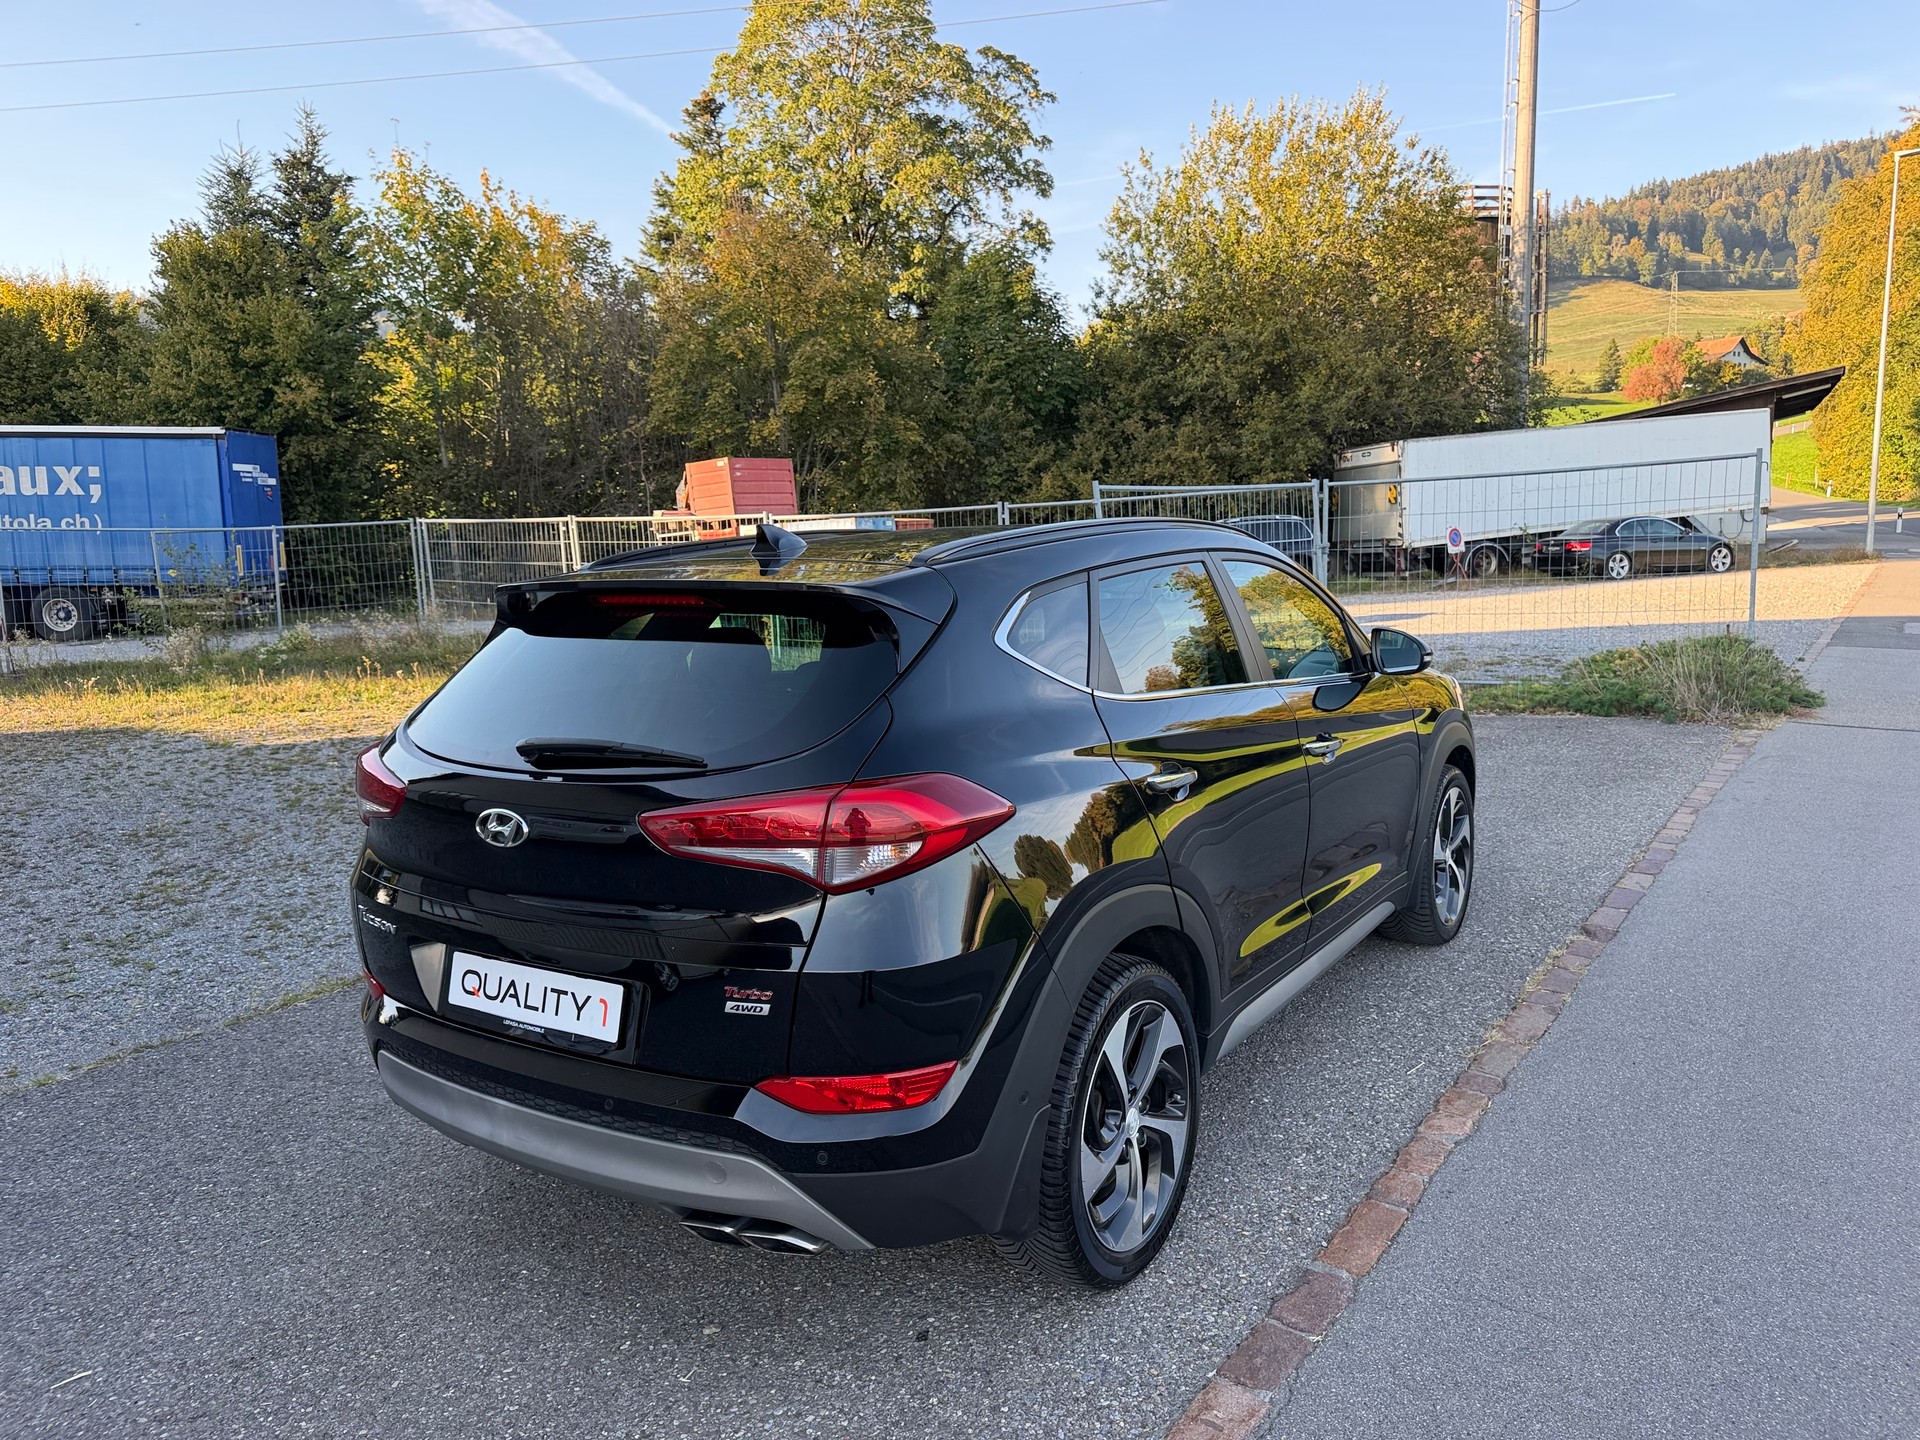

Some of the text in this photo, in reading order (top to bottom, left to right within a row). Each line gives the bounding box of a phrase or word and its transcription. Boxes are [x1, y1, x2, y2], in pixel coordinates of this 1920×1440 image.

[0, 513, 102, 535] tolach)
[724, 986, 774, 1001] Turbo
[730, 1004, 764, 1014] 4WD
